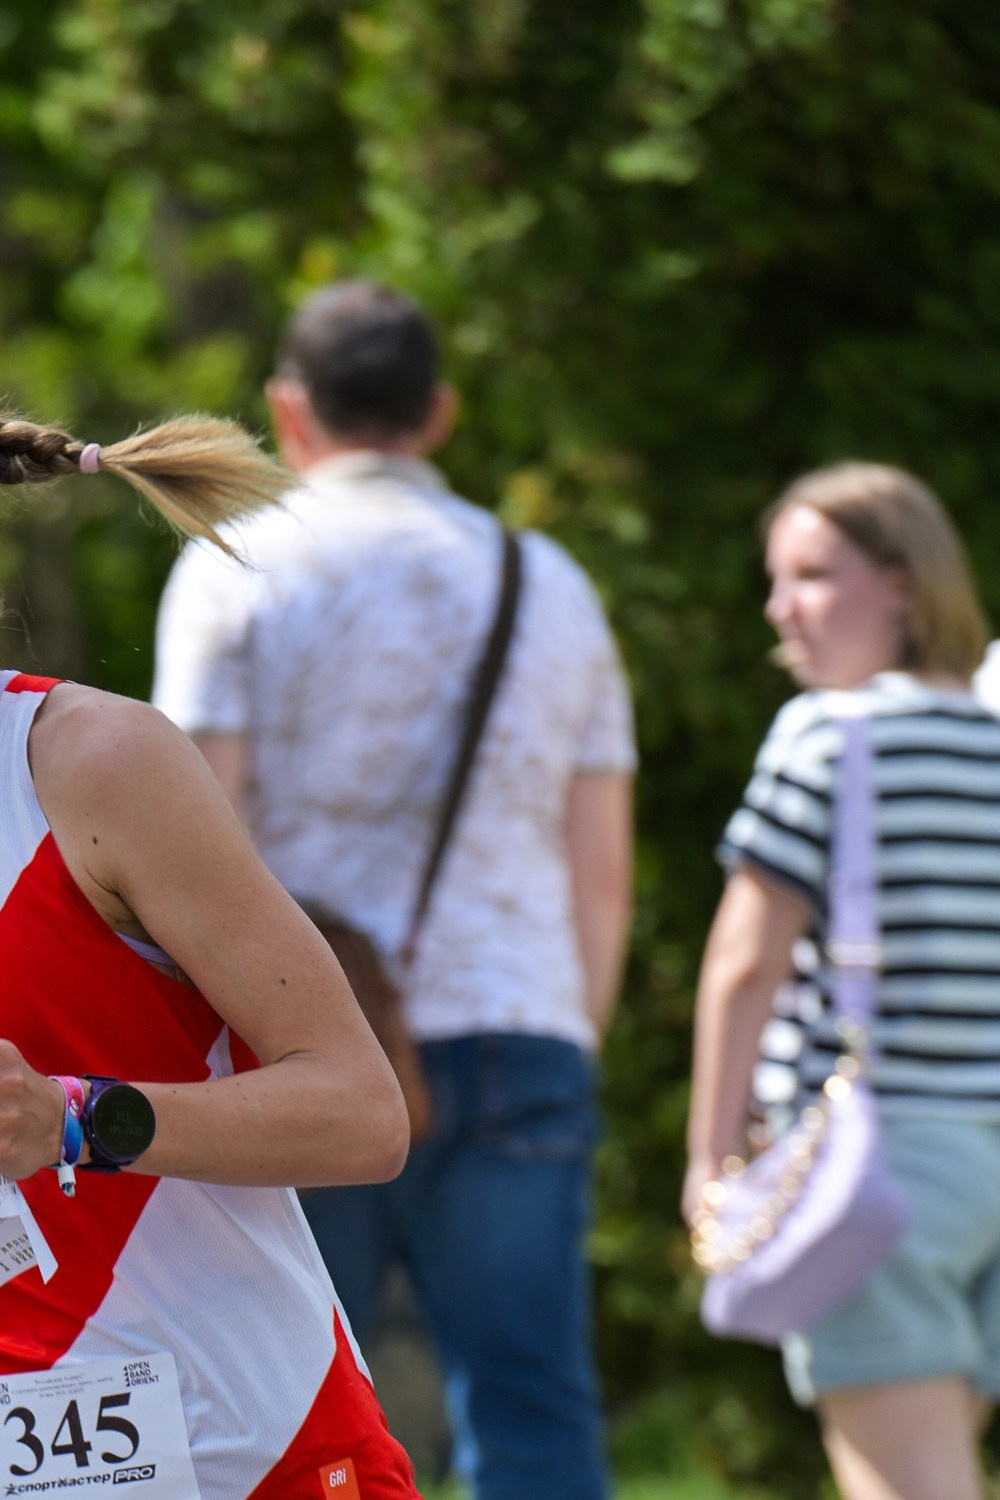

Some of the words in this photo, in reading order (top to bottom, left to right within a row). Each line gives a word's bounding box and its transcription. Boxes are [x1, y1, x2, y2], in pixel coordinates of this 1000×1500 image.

[128, 1361, 150, 1371] OPEN
[129, 1370, 151, 1379] BAND
[130, 1375, 160, 1387] ORIENT
[3, 1391, 140, 1477] 345
[115, 1467, 154, 1482] PRO
